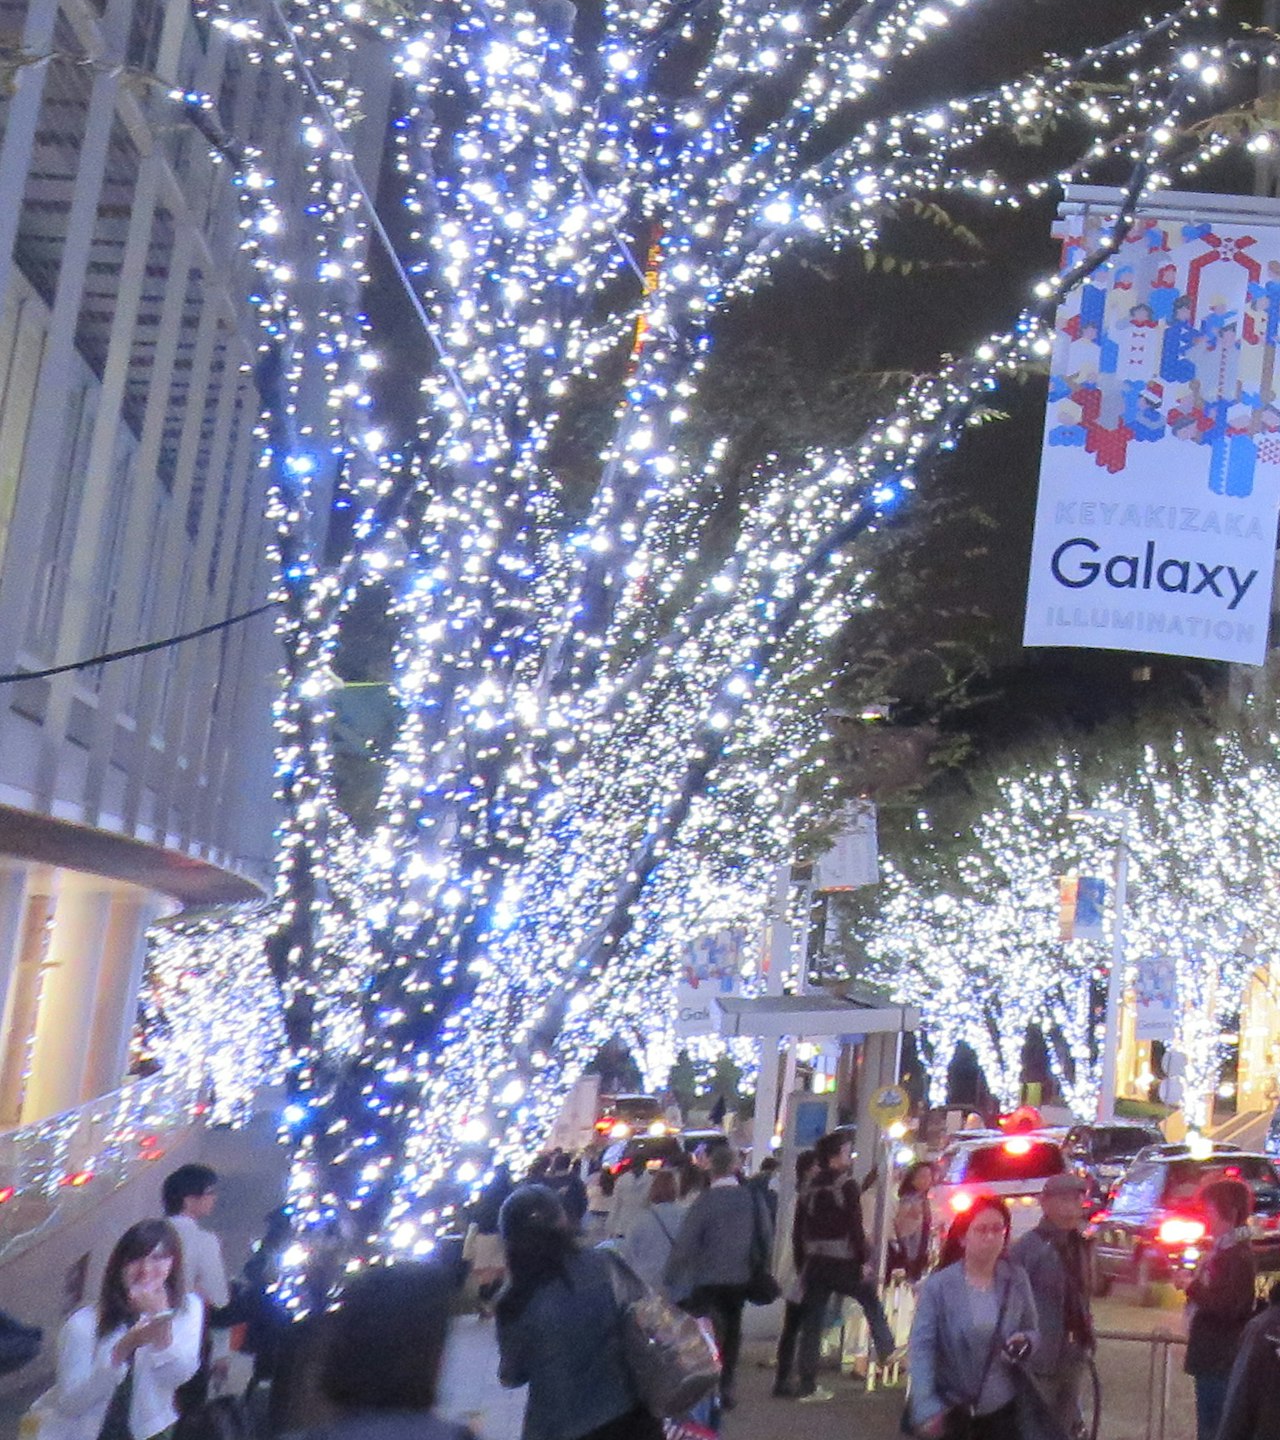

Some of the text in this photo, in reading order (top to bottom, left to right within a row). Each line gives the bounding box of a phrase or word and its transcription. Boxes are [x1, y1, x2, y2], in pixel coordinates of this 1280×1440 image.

[1055, 501, 1263, 540] KEYAKIZAKA
[1051, 537, 1259, 610] Galaxy
[1047, 606, 1256, 643] ILLUMINATION
